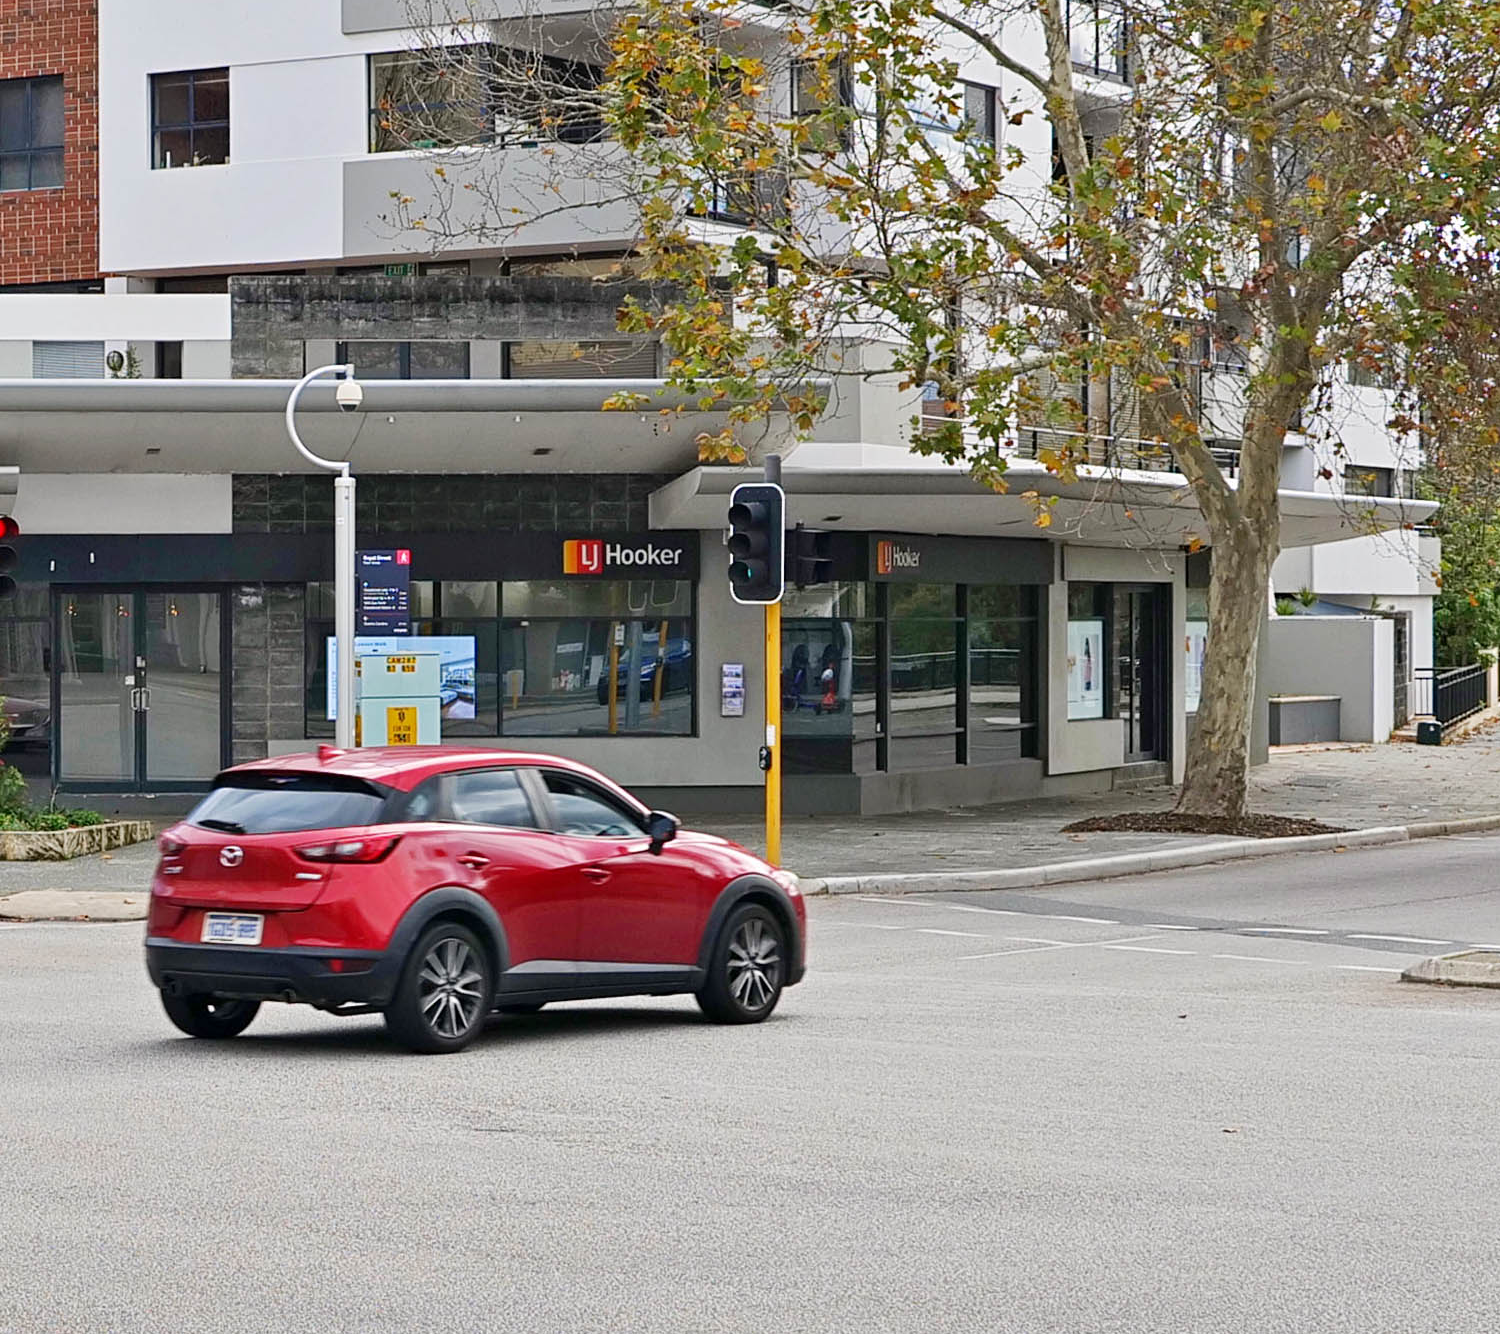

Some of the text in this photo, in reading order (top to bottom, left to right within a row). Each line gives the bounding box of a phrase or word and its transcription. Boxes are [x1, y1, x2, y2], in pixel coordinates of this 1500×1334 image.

[582, 544, 682, 571] LJ Hooker
[893, 546, 921, 567] Hooker
